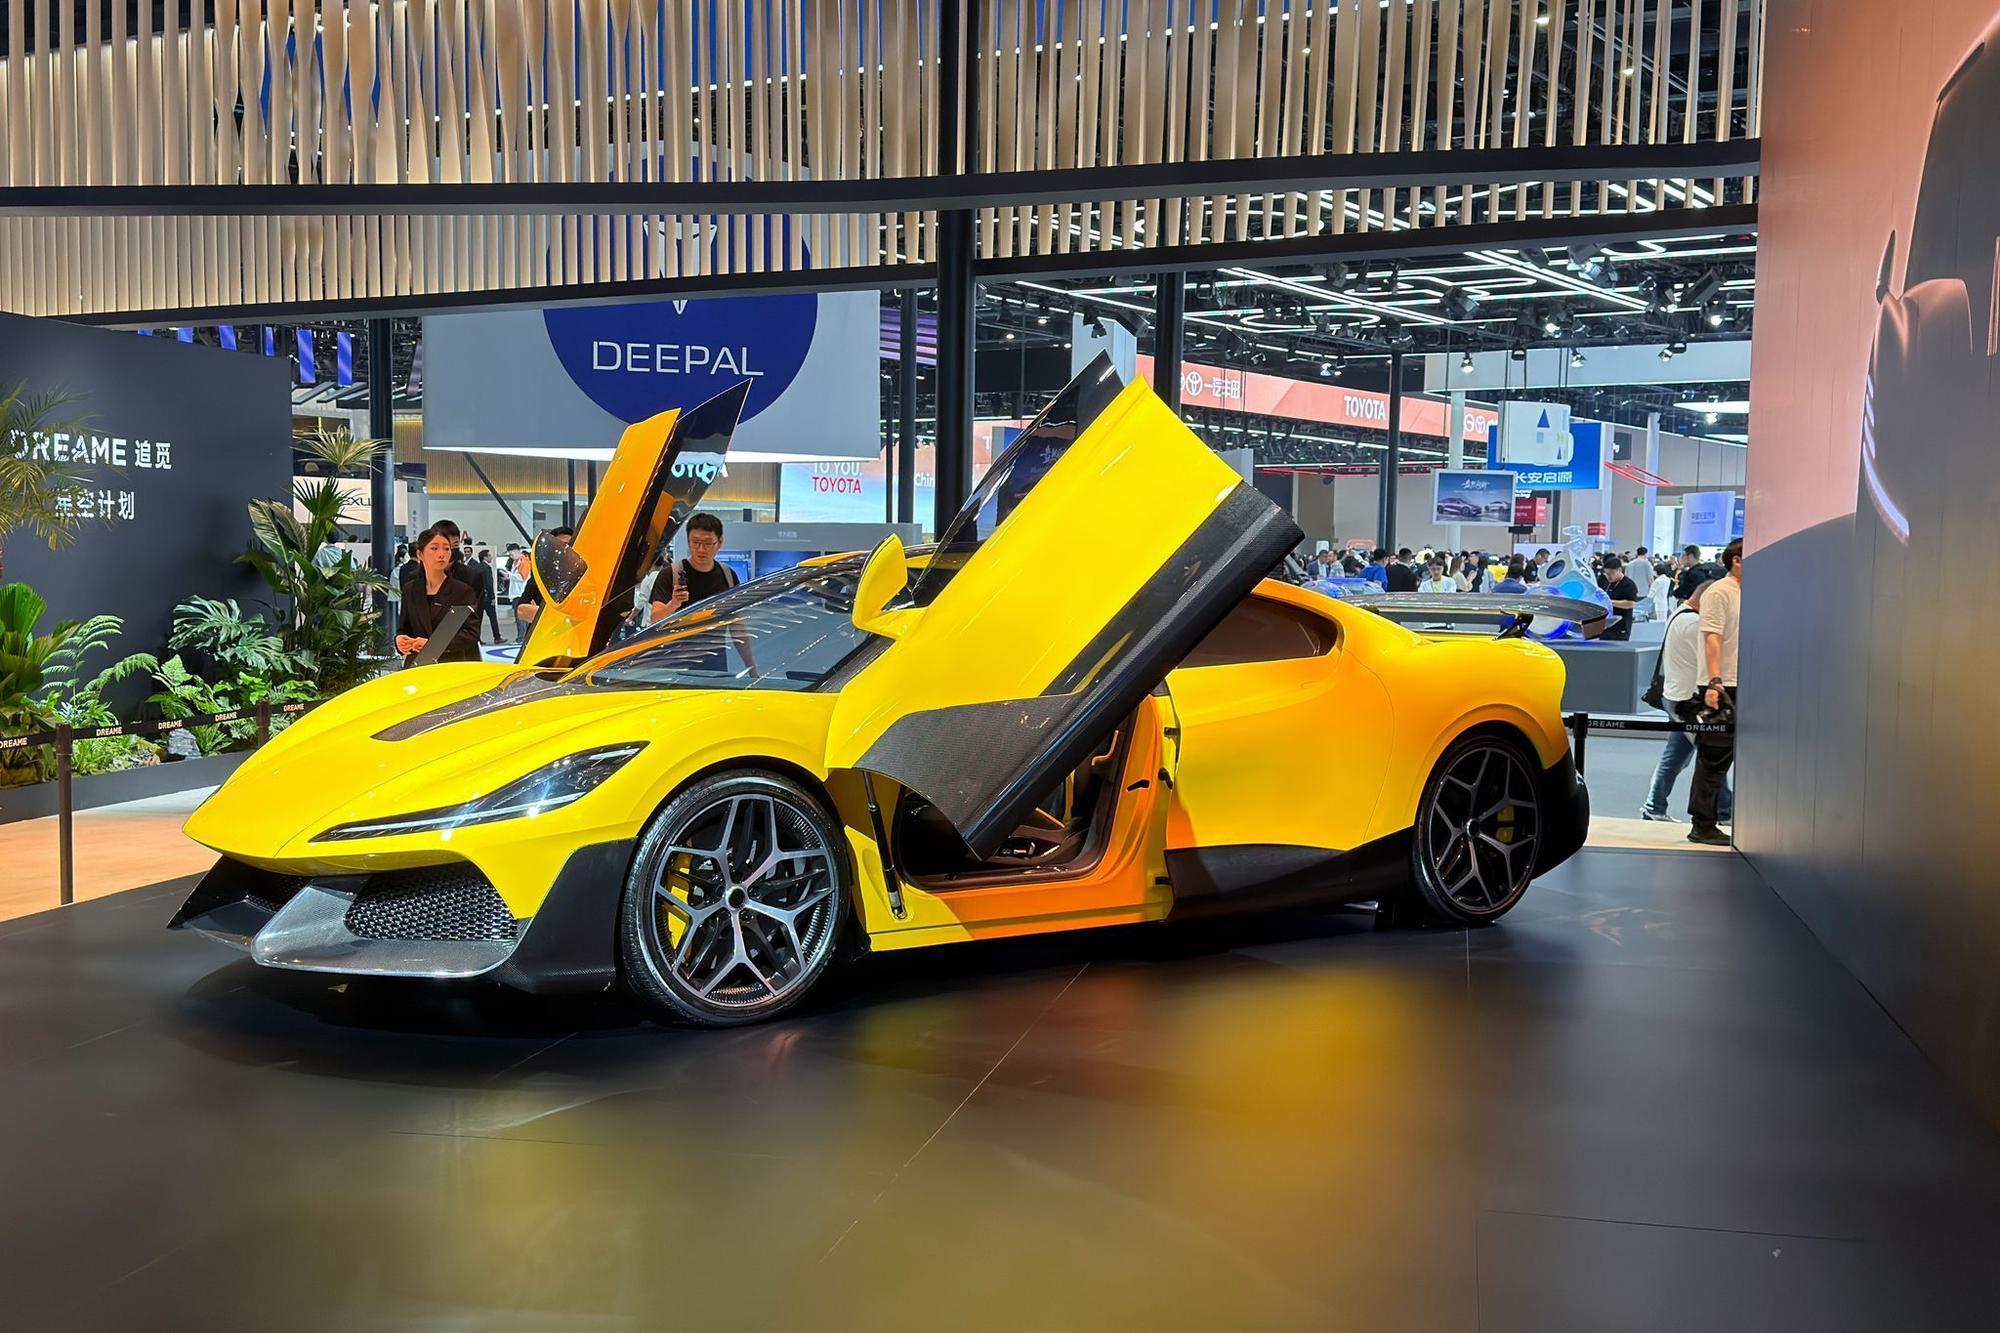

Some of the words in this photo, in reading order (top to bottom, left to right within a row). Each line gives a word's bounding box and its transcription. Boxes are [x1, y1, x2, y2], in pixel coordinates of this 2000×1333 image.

[592, 341, 764, 376] DEEPAL
[1204, 376, 1241, 399] 一汽丰田
[1344, 396, 1387, 420] TOYOTA
[134, 439, 172, 470] 追觅
[812, 476, 862, 494] TOYOTA
[914, 472, 935, 487] Chin
[283, 703, 305, 712] DREAME
[214, 711, 238, 722] DREAME
[95, 726, 123, 737] DREAME
[158, 719, 183, 730] DREAME
[1686, 724, 1726, 732] DREAME
